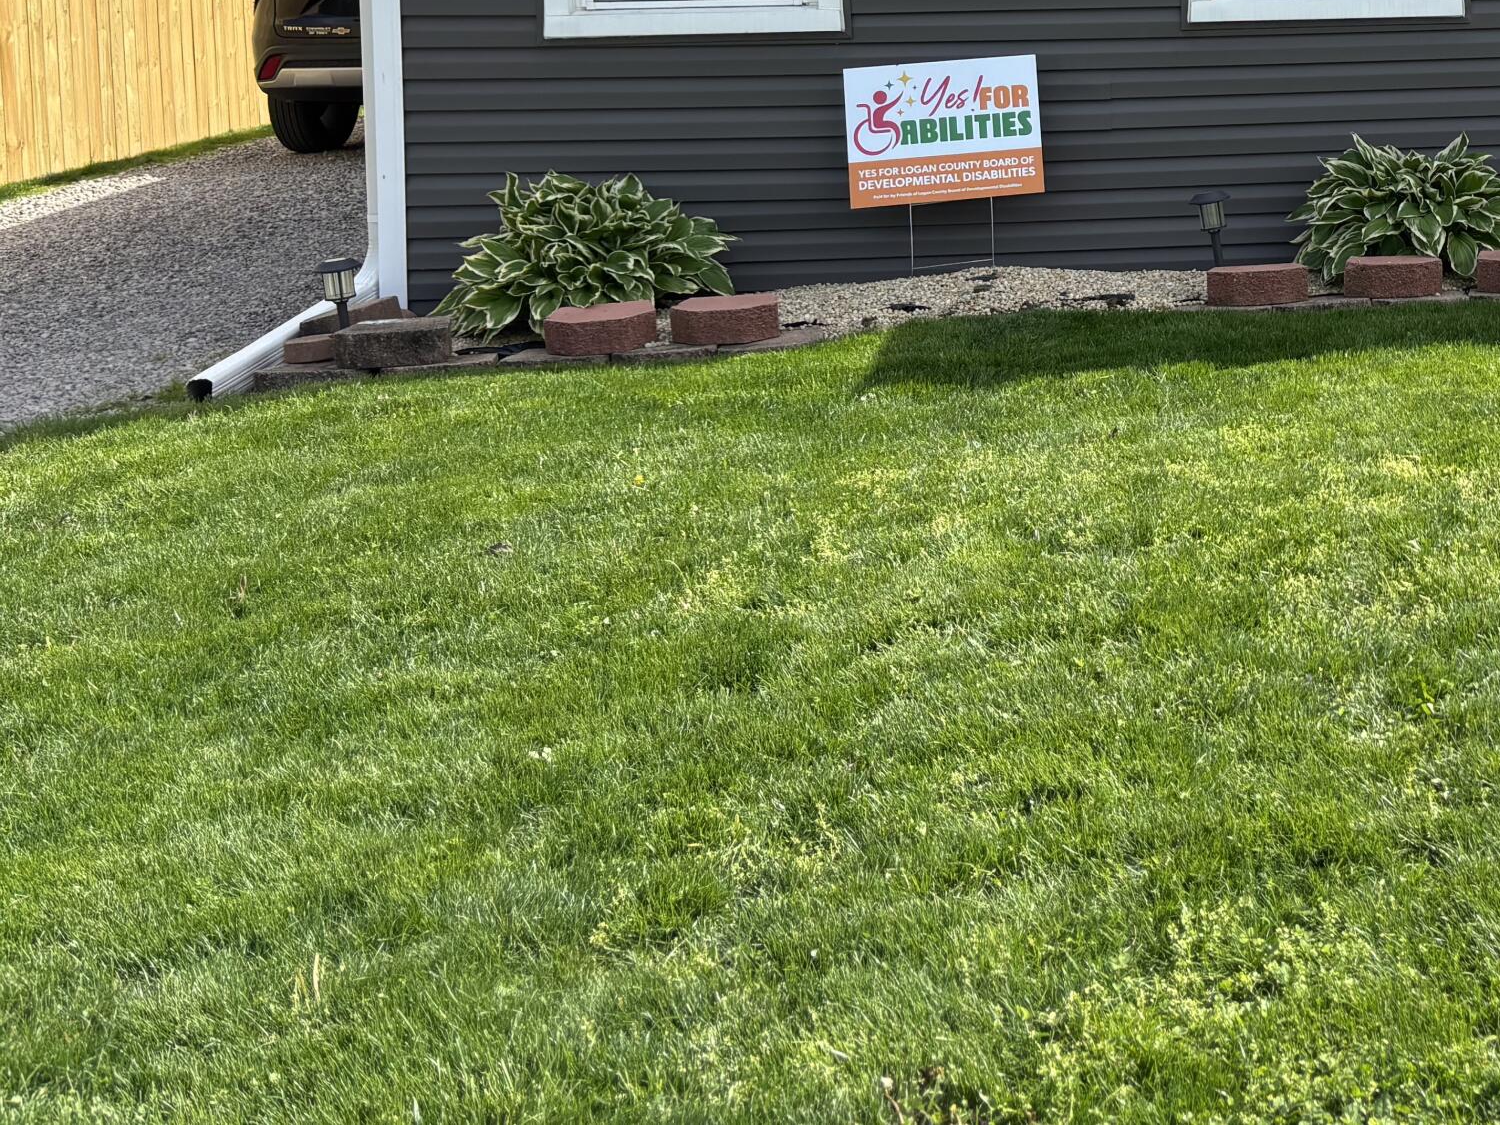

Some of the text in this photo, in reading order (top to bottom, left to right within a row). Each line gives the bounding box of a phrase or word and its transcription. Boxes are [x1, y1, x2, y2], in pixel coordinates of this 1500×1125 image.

[920, 75, 1030, 117] Yes! FOR
[900, 110, 1033, 146] ABILITIES
[858, 155, 1035, 178] YES FOR LOGAN COUNTY BOARD OF
[858, 166, 1036, 191] DEVELOPMENTAL DISABILITIES
